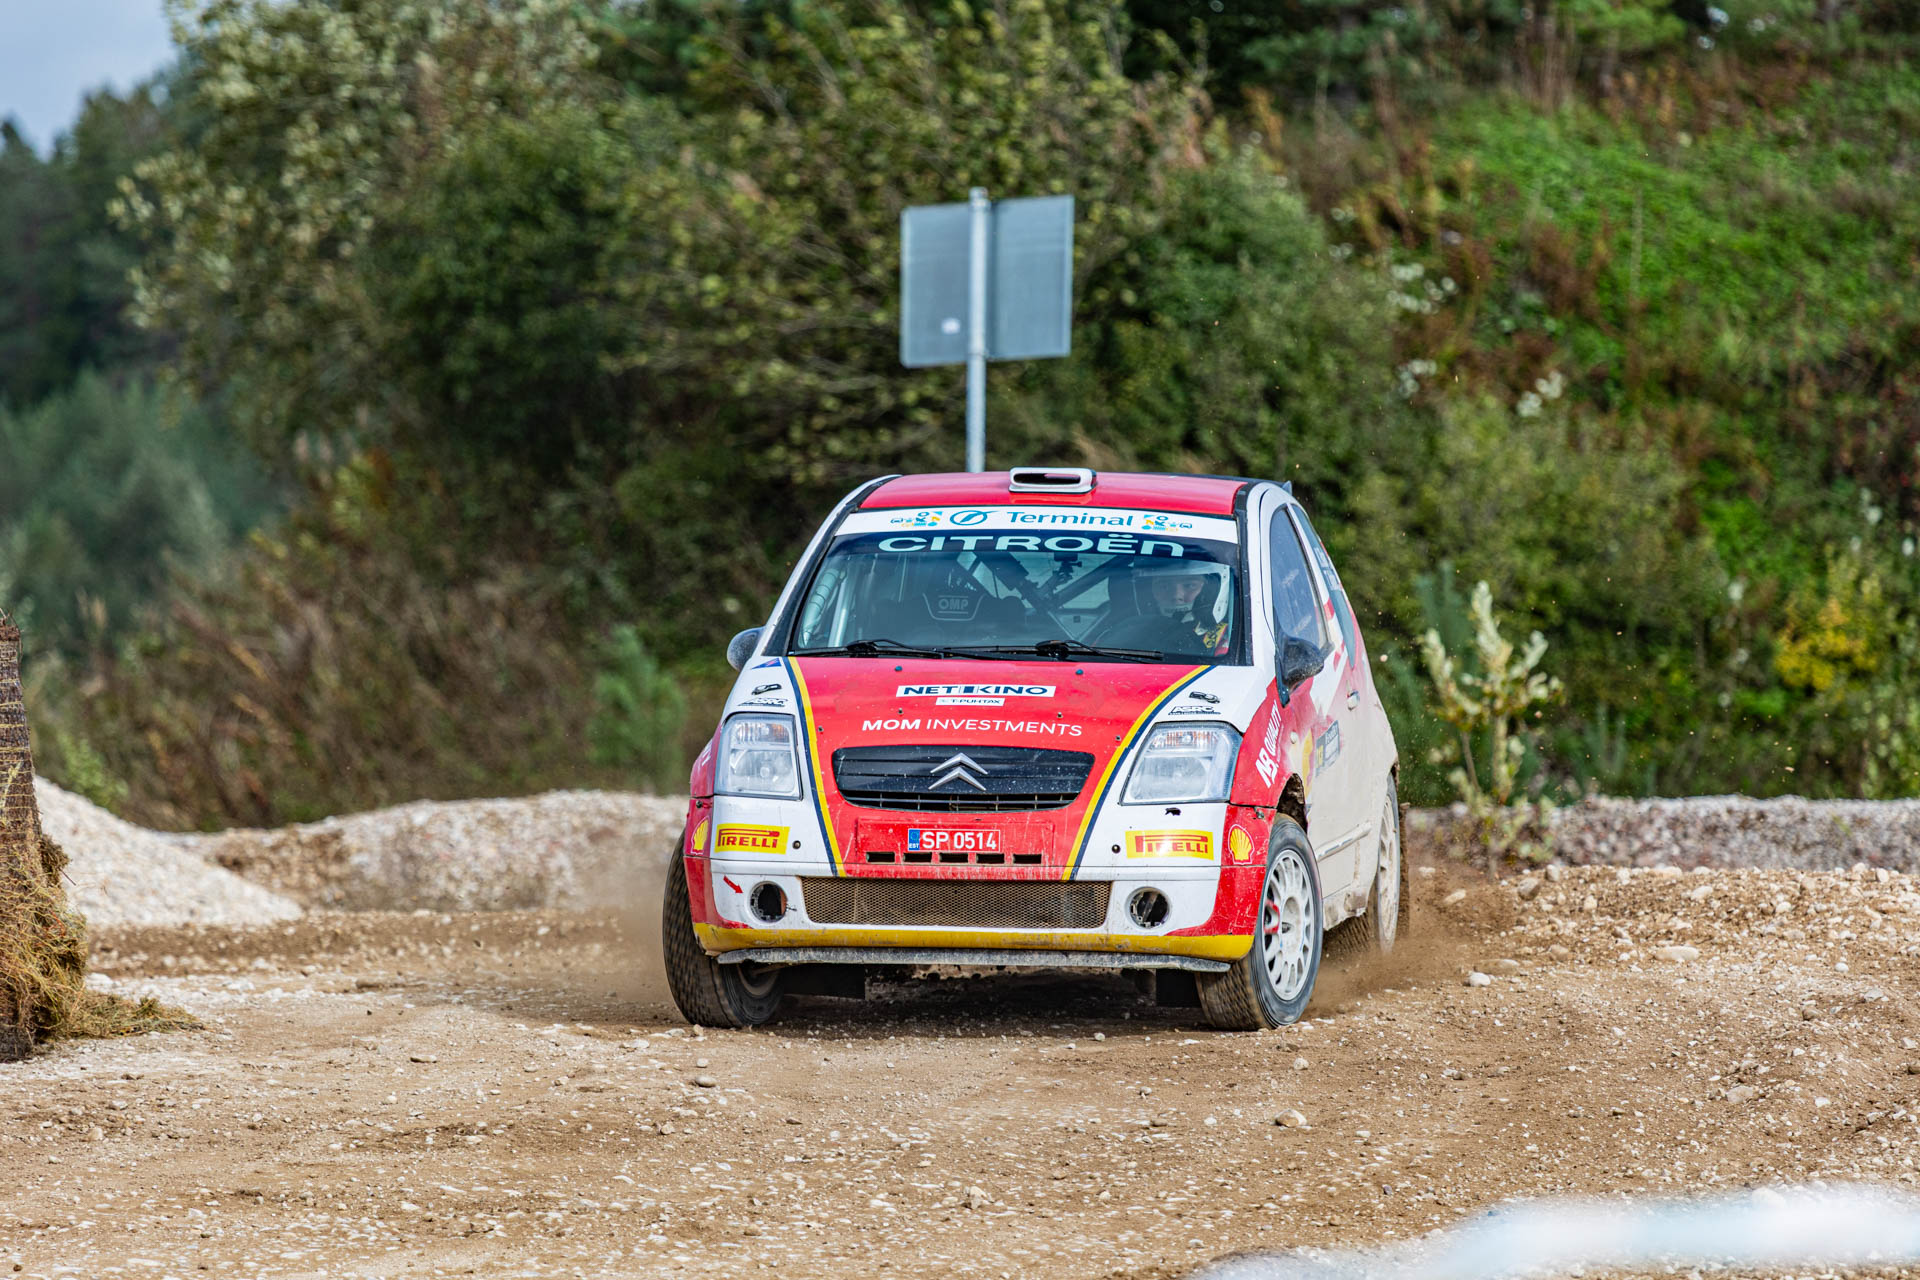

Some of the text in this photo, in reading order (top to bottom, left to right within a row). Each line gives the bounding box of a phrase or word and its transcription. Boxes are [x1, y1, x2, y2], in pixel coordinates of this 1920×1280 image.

[1007, 511, 1133, 526] Terminal
[938, 598, 969, 610] OMP
[862, 719, 1082, 736] MOM INVESTMENTS
[717, 828, 780, 848] PIRELLI
[922, 832, 949, 849] SP
[953, 832, 997, 850] 0514
